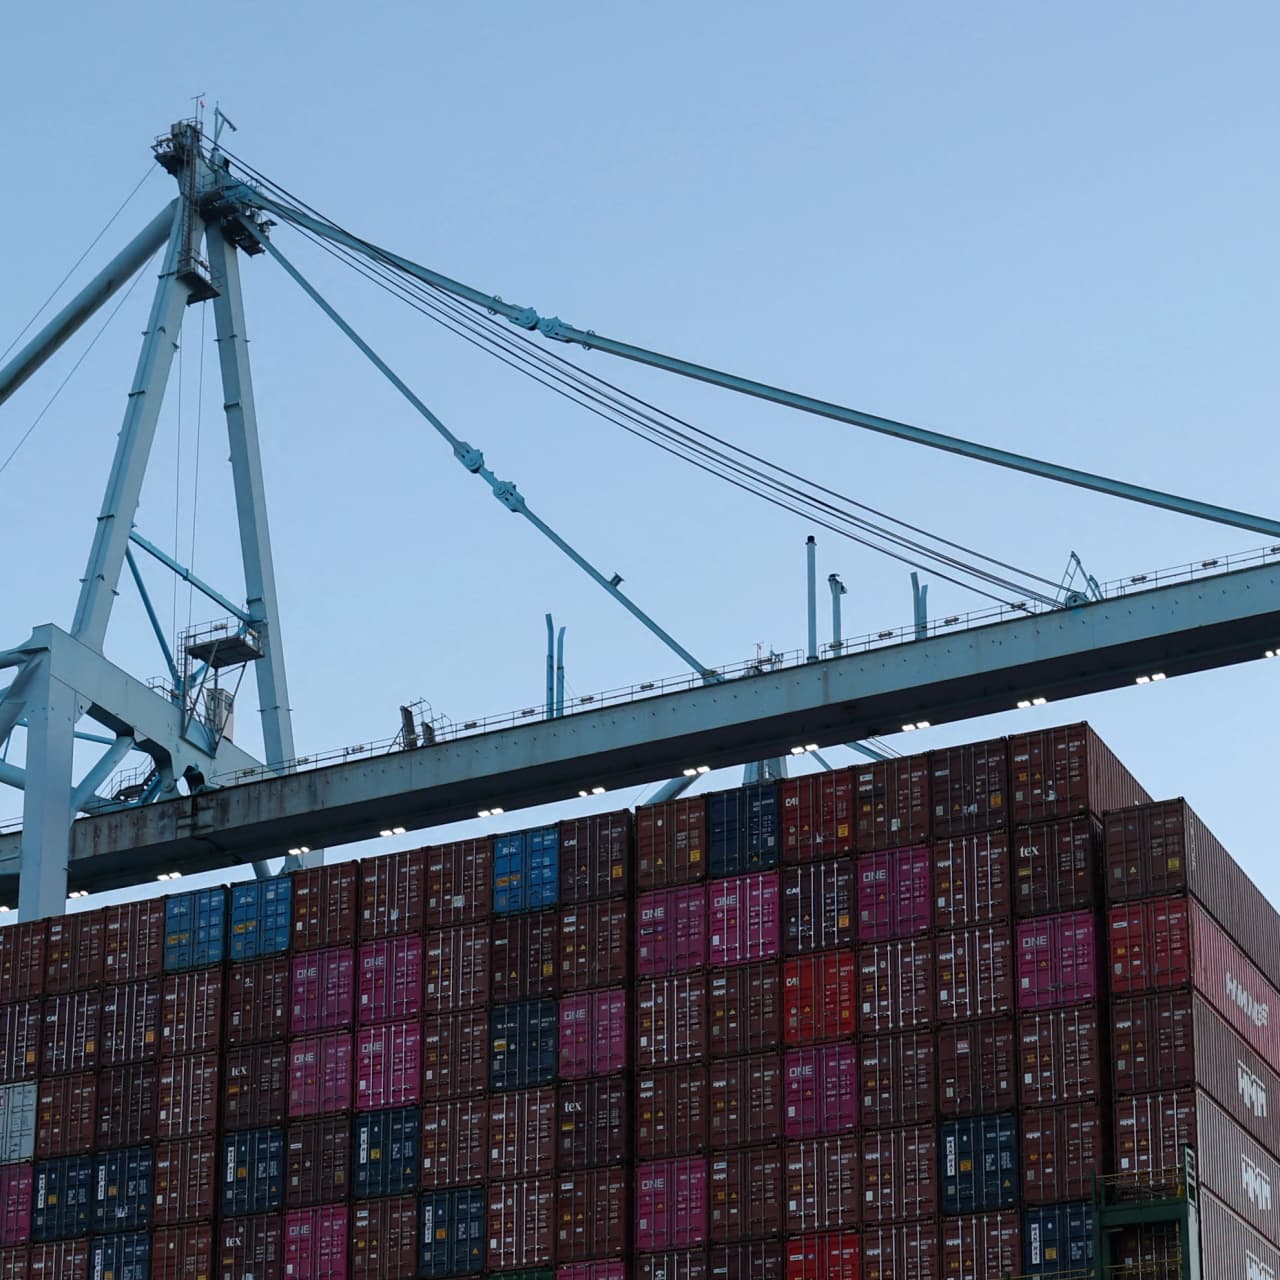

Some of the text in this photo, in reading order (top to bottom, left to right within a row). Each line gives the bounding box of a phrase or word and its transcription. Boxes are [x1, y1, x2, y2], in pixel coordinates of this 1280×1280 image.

[863, 869, 887, 881] ONE
[642, 907, 665, 919] ONE
[1023, 935, 1047, 947] ONE
[364, 956, 384, 968] ONE
[297, 967, 317, 978] ONE
[564, 1008, 585, 1020] ONE
[294, 1053, 314, 1063] ONE
[789, 1065, 813, 1077] ONE
[641, 1179, 665, 1190] ONE
[289, 1224, 310, 1235] ONE
